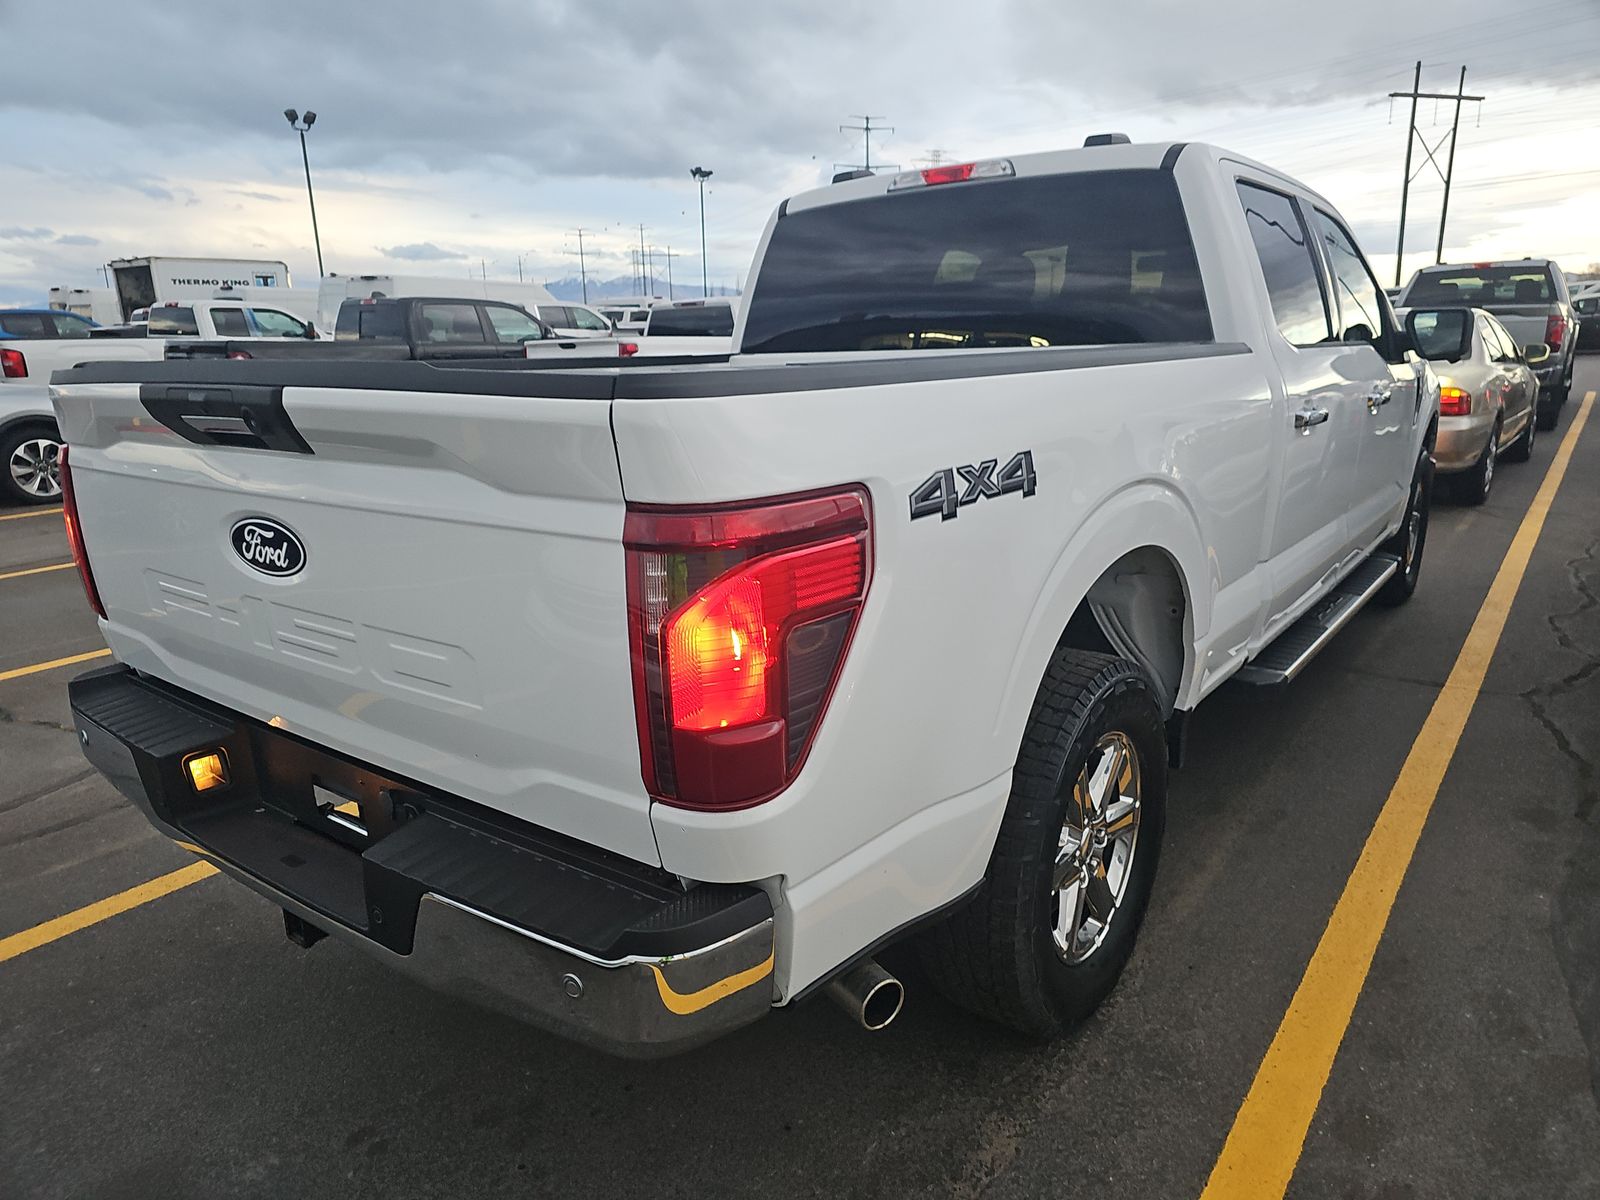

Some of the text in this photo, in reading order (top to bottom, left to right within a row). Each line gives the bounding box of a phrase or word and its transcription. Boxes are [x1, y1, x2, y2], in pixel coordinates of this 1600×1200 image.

[171, 279, 250, 287] THERMO KING
[242, 525, 289, 568] Ford
